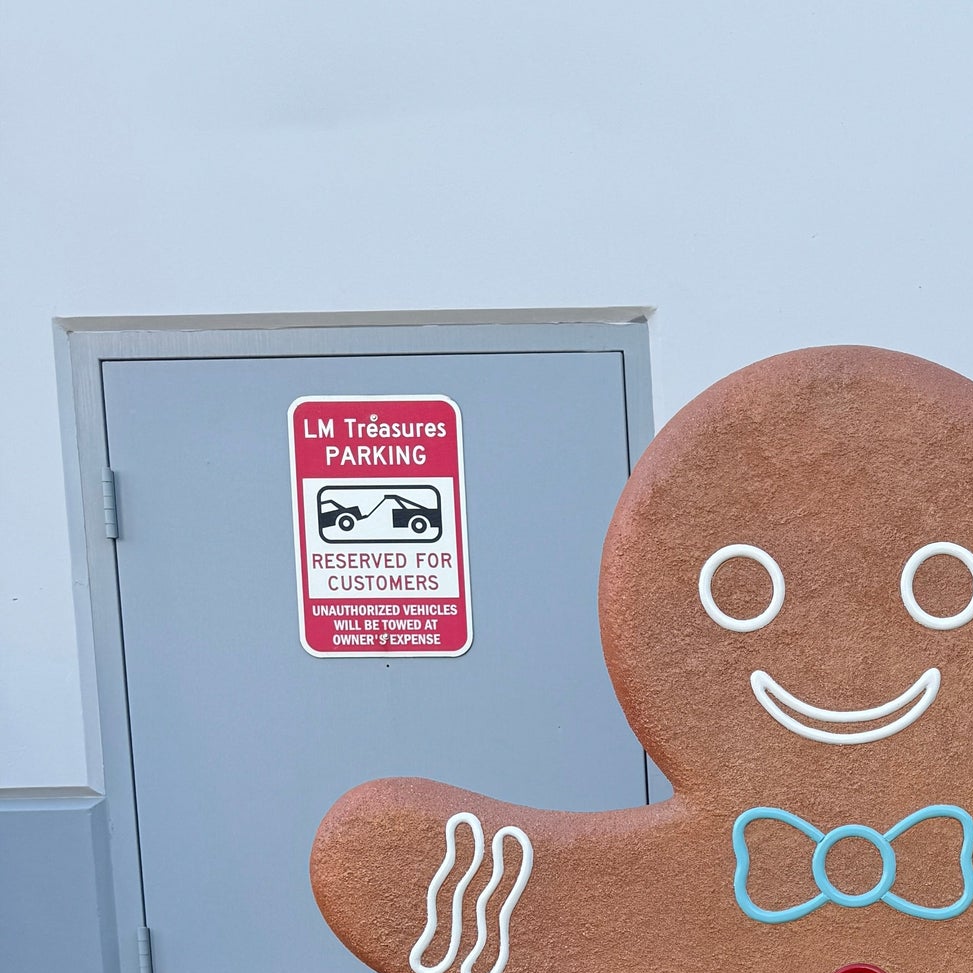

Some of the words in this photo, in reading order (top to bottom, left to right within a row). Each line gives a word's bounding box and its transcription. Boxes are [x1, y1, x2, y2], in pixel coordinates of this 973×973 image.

[304, 419, 334, 438] LM
[344, 418, 447, 438] Treasures
[326, 445, 426, 465] PARKING
[312, 554, 407, 569] RESERVED
[417, 553, 452, 568] FOR
[328, 575, 439, 591] CUSTOMERS
[312, 605, 401, 616] UNAUTHORIZED
[403, 605, 457, 615] VEHICLES
[334, 620, 362, 631] WILL
[364, 620, 379, 630] BE
[382, 620, 422, 630] TOWED
[424, 620, 438, 630] AT
[390, 634, 440, 645] EXPENSE
